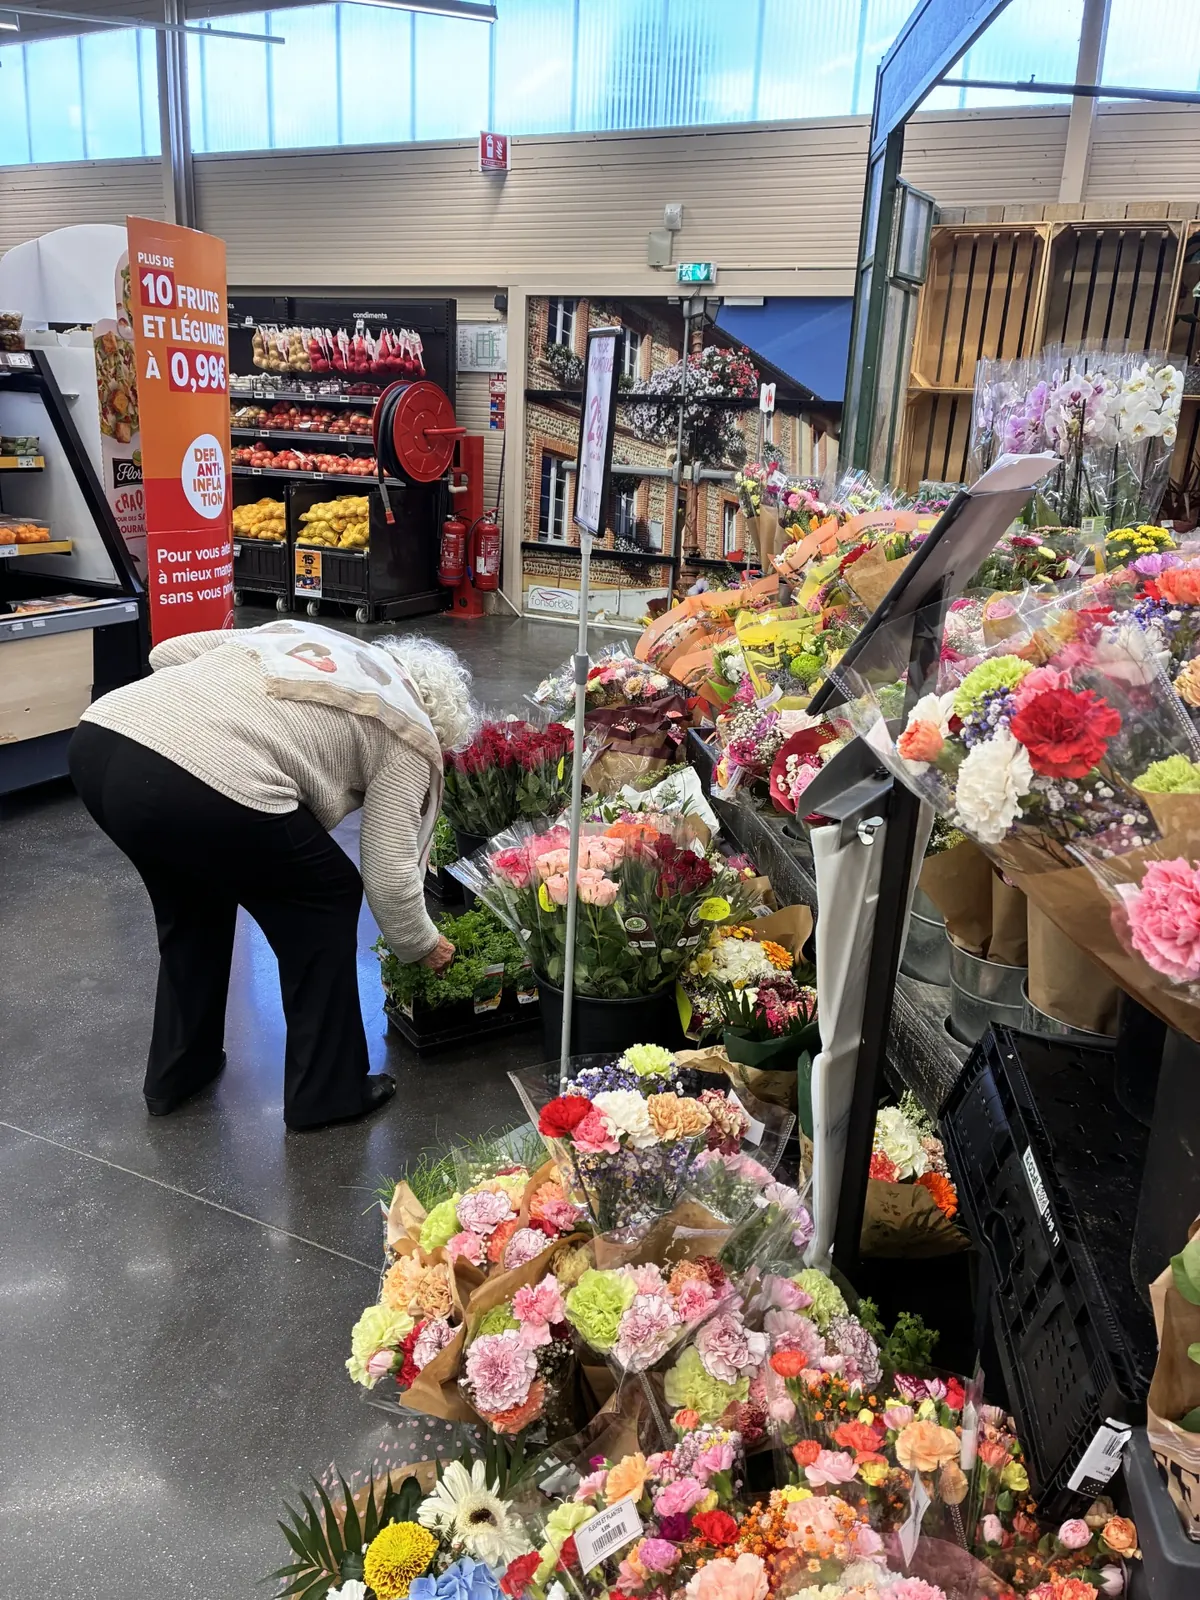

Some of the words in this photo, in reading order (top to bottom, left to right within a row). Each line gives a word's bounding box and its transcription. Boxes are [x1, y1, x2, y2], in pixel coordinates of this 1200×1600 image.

[138, 252, 161, 266] PLUS
[163, 256, 174, 268] DE
[142, 273, 173, 306] 10
[177, 285, 219, 314] FRUITS
[143, 315, 166, 339] ET
[171, 313, 225, 347] LÉGUMES
[145, 350, 161, 379] À
[171, 352, 226, 393] 0,99€
[194, 448, 217, 462] DEFI
[197, 463, 222, 477] ANTI-
[192, 477, 222, 492] INFLA
[200, 492, 223, 507] TION
[157, 548, 192, 564] Pour
[195, 547, 220, 560] vous
[158, 569, 168, 584] à
[172, 568, 212, 583] mieux
[159, 591, 194, 605] sans
[197, 587, 222, 601] vous
[588, 1521, 602, 1534] FLEURS
[601, 1516, 607, 1524] ET
[606, 1507, 623, 1520] PLANTES
